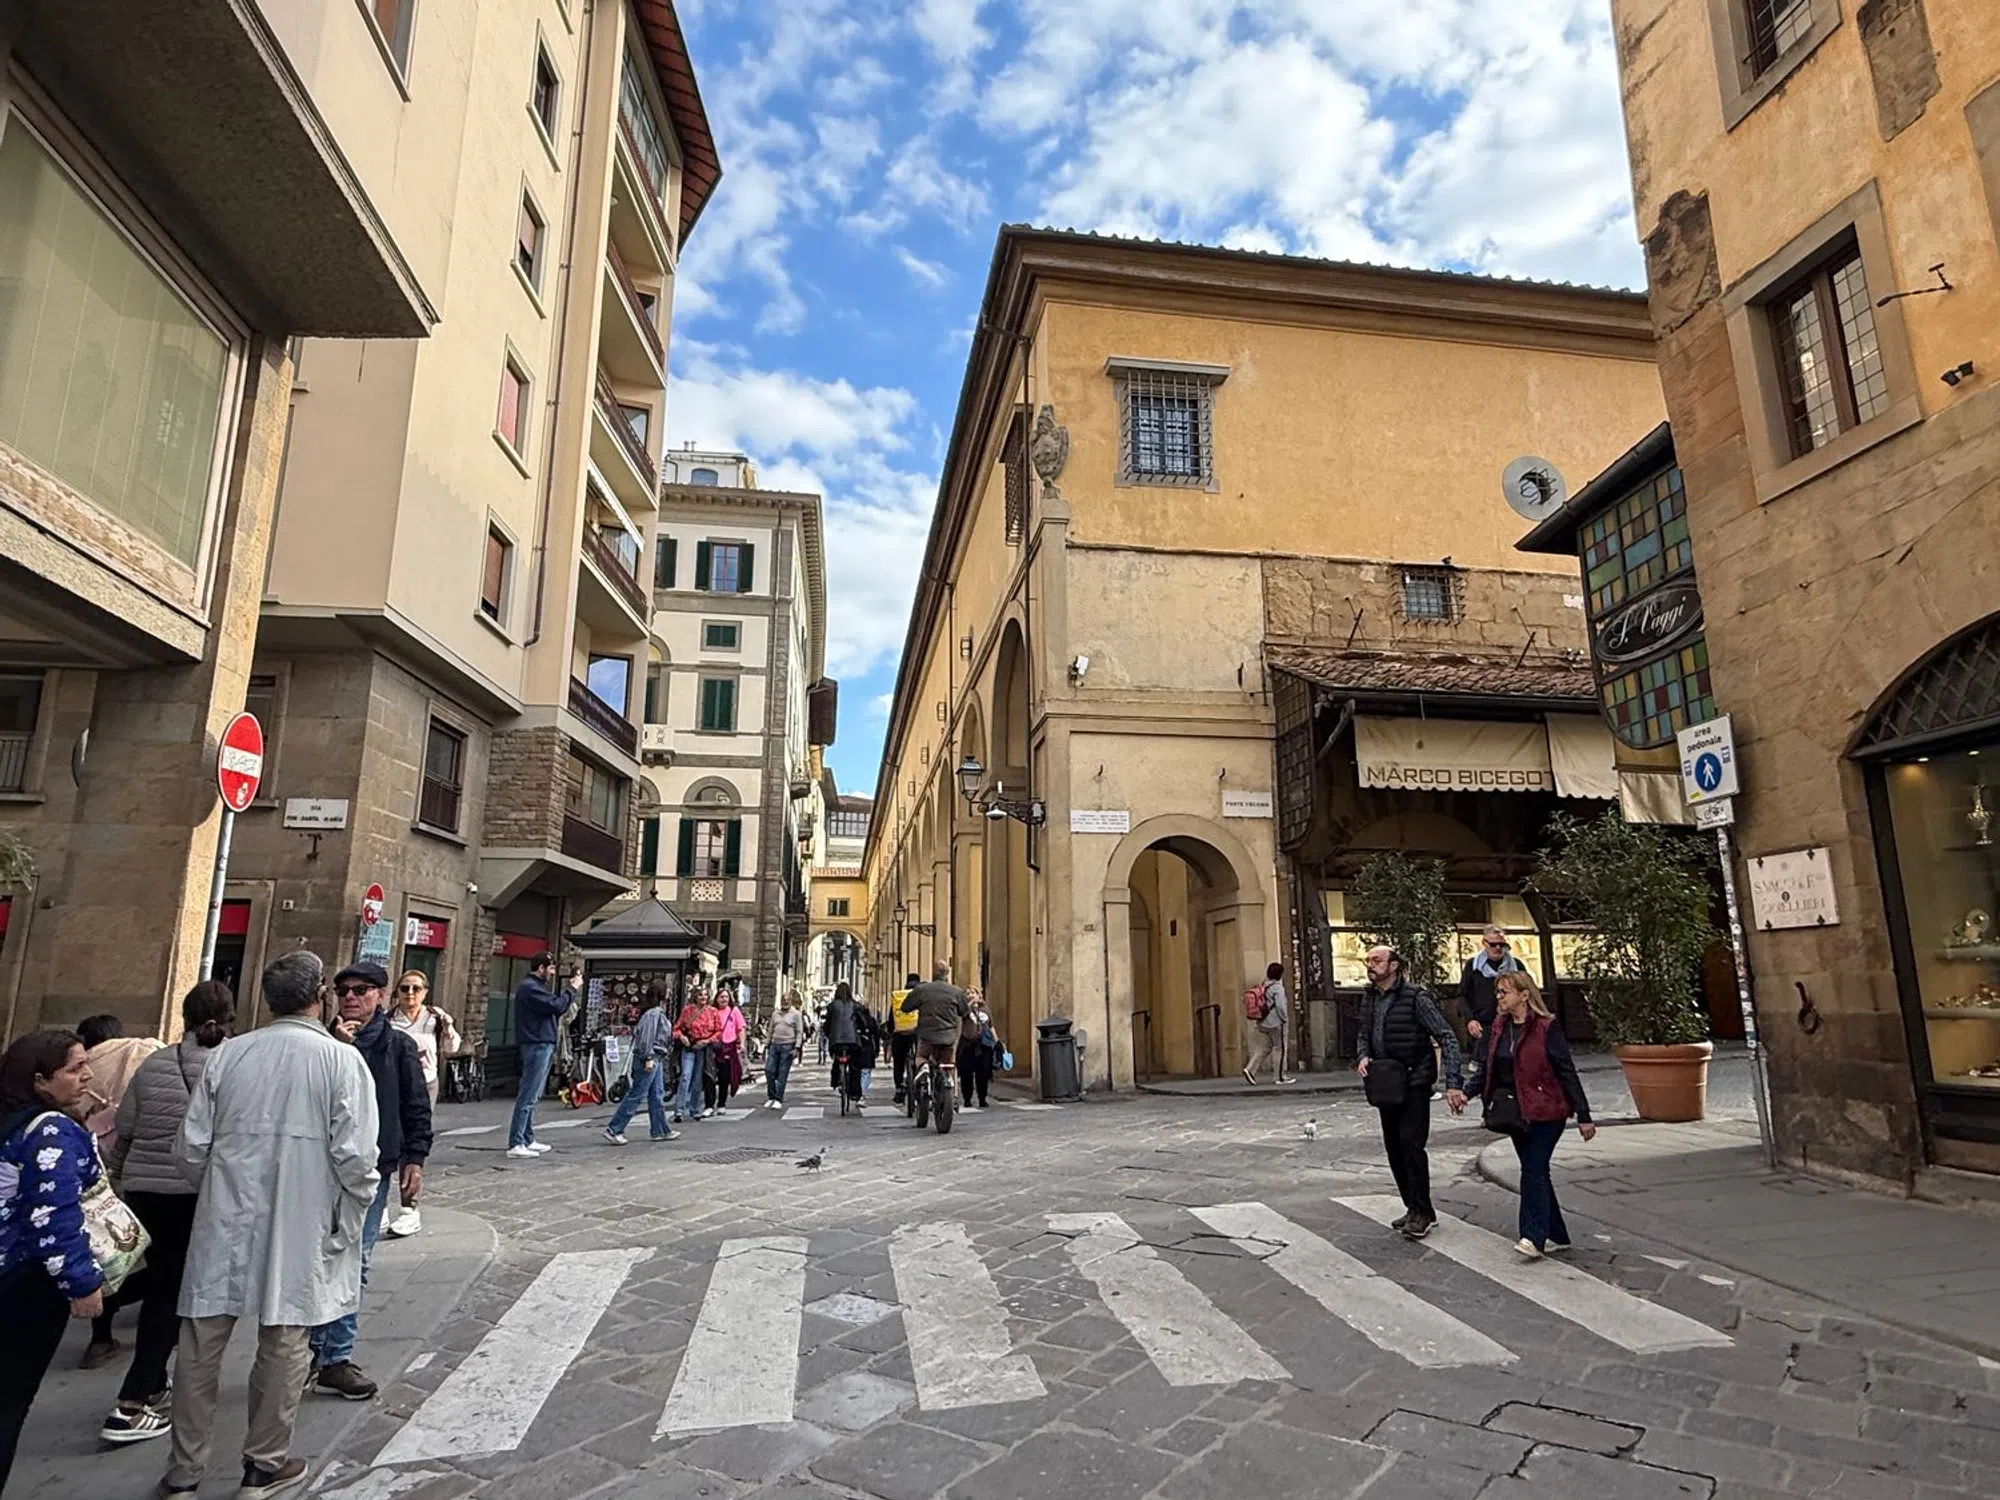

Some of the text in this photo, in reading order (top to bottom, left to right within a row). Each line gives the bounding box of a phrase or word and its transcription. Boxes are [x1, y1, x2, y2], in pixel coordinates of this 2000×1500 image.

[1694, 726, 1712, 738] area
[1686, 735, 1723, 753] pedonale
[1366, 765, 1543, 786] MARCO BICEGO
